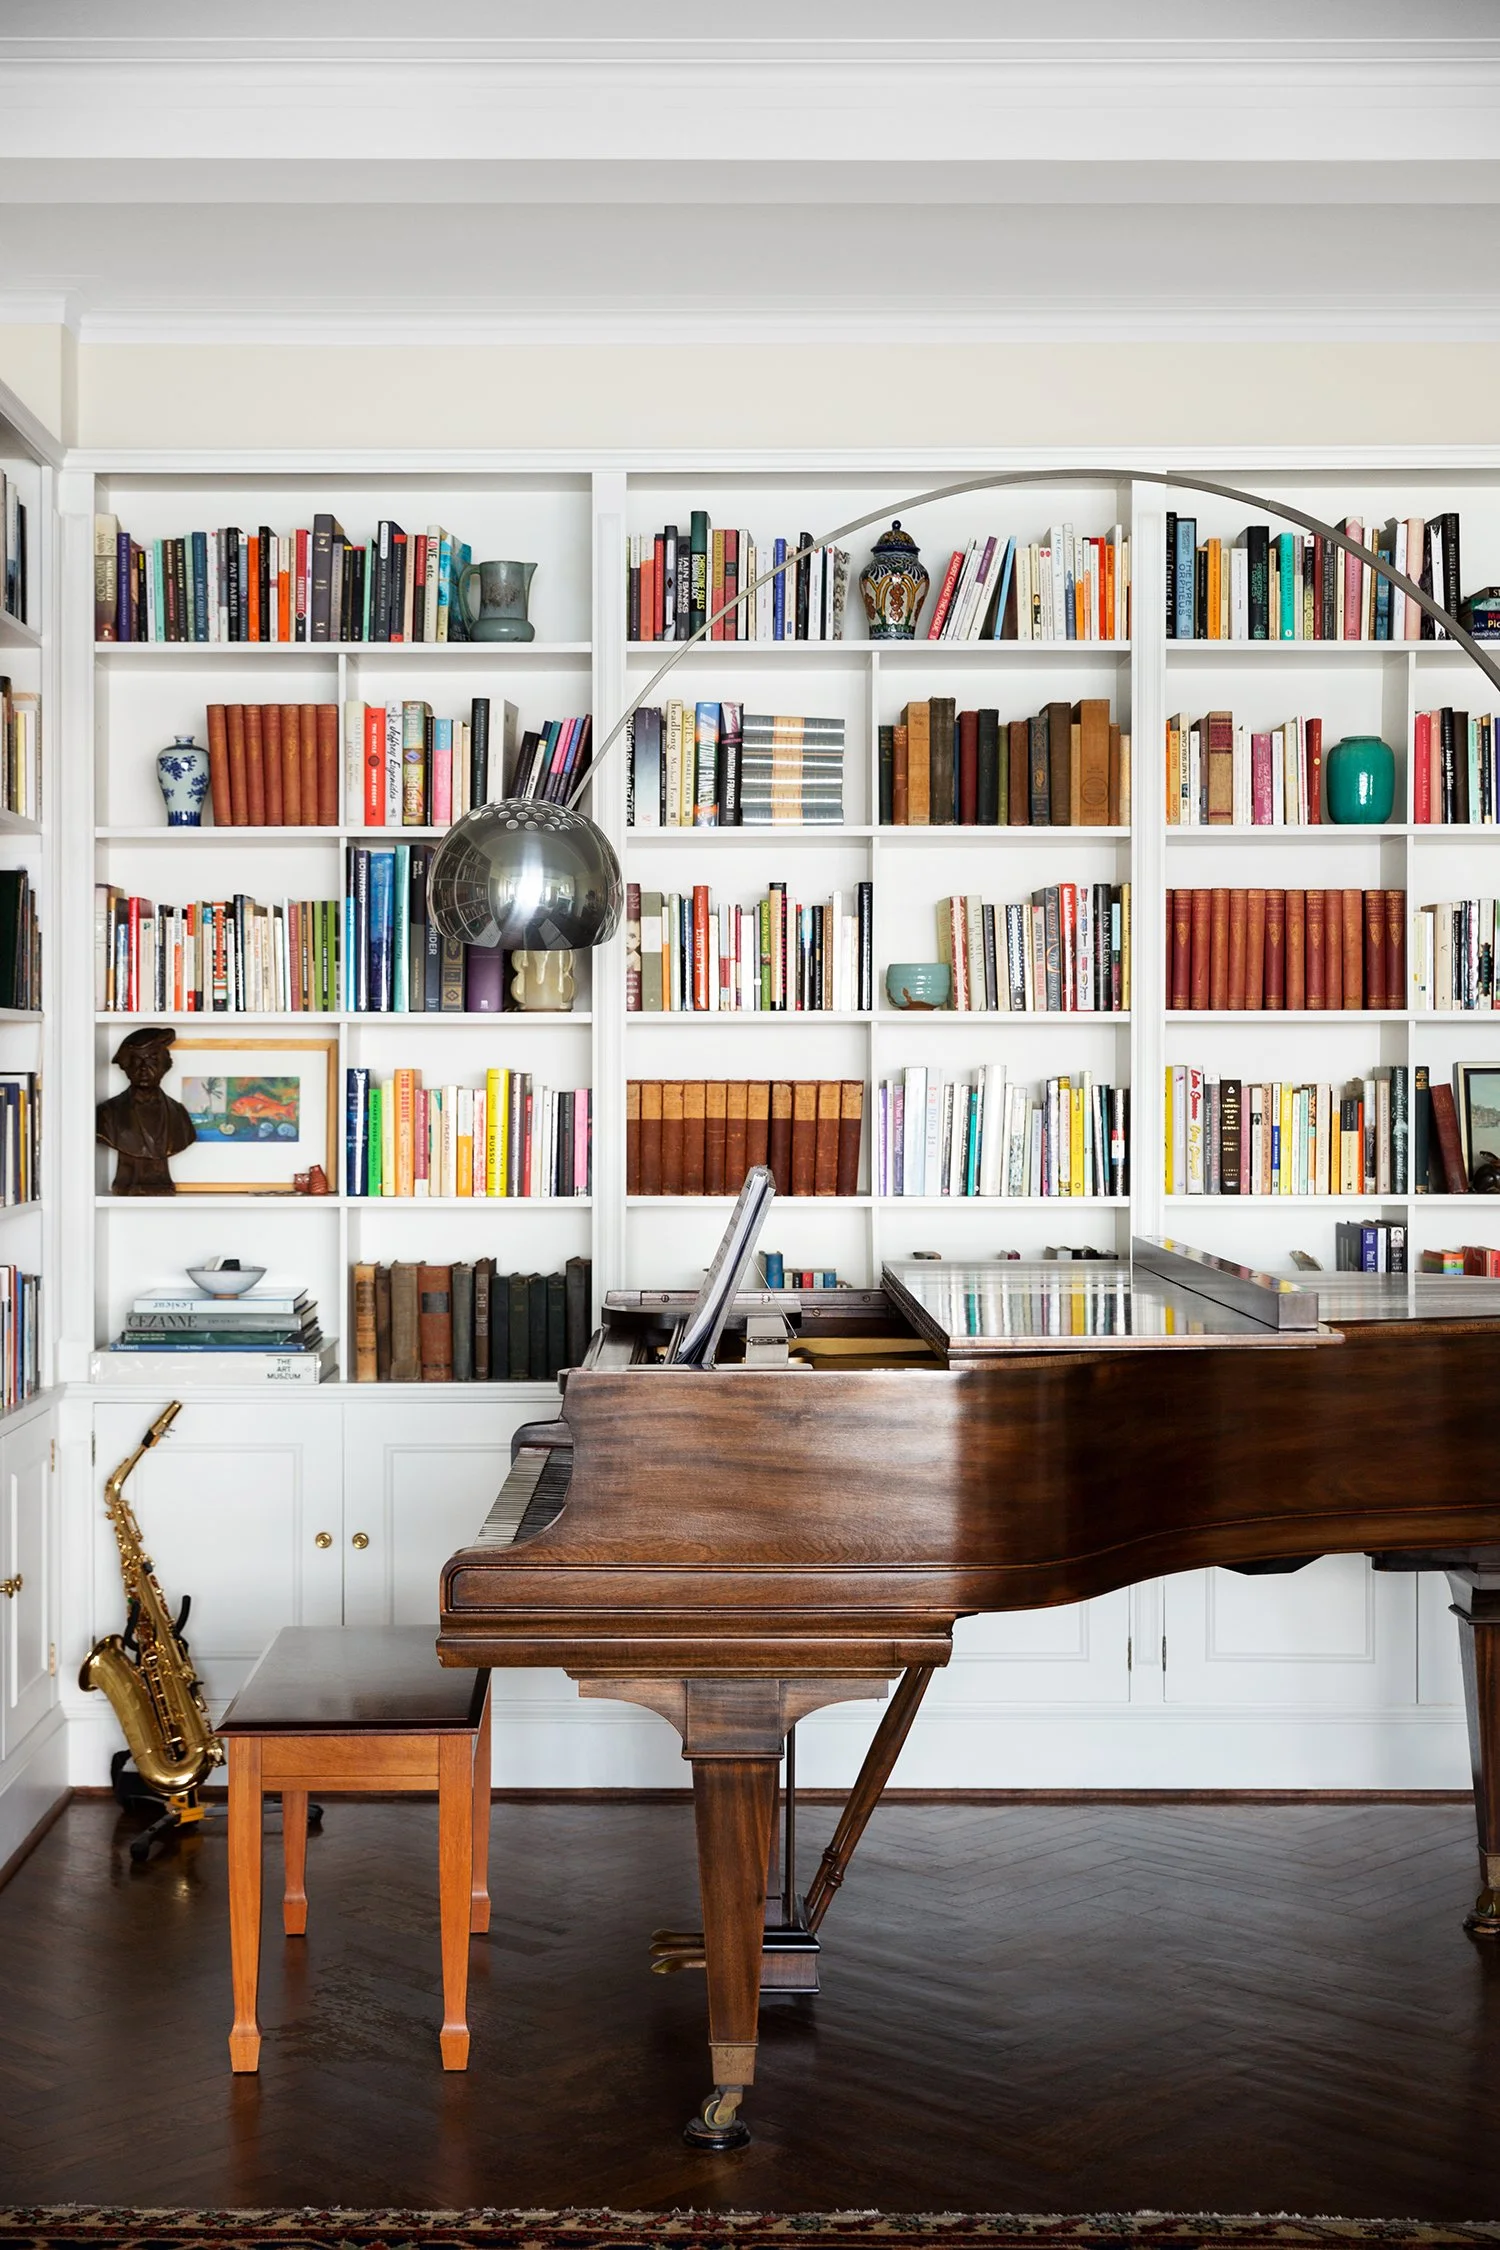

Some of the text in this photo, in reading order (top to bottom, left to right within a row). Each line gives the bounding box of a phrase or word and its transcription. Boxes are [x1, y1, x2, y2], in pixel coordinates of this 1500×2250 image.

[427, 536, 437, 561] LOVE,
[96, 560, 106, 602] ATWOOD
[297, 576, 306, 610] FAHRENHEIT
[697, 554, 705, 609] CHRISTINE FALLS
[932, 555, 960, 631] ALBERT CAMUS THE PLAGUE
[1166, 564, 1174, 598] CUNNING
[1186, 608, 1192, 620] OF
[668, 704, 680, 750] headlong
[685, 714, 693, 744] SPIES
[385, 726, 401, 800] Jeffrey Eugenides
[697, 770, 714, 806] FRANZEN
[726, 779, 734, 809] FRANZEN
[359, 858, 367, 903] BONNARD
[1048, 895, 1057, 934] PARADISE
[429, 928, 437, 955] RIDER
[696, 928, 704, 948] Life
[762, 926, 768, 934] My
[696, 950, 703, 959] of
[696, 964, 704, 973] Pi
[401, 1073, 409, 1089] TOM
[895, 1126, 903, 1155] Painting?
[1366, 1232, 1375, 1262] Long Paul
[129, 1315, 198, 1328] CEZANNE
